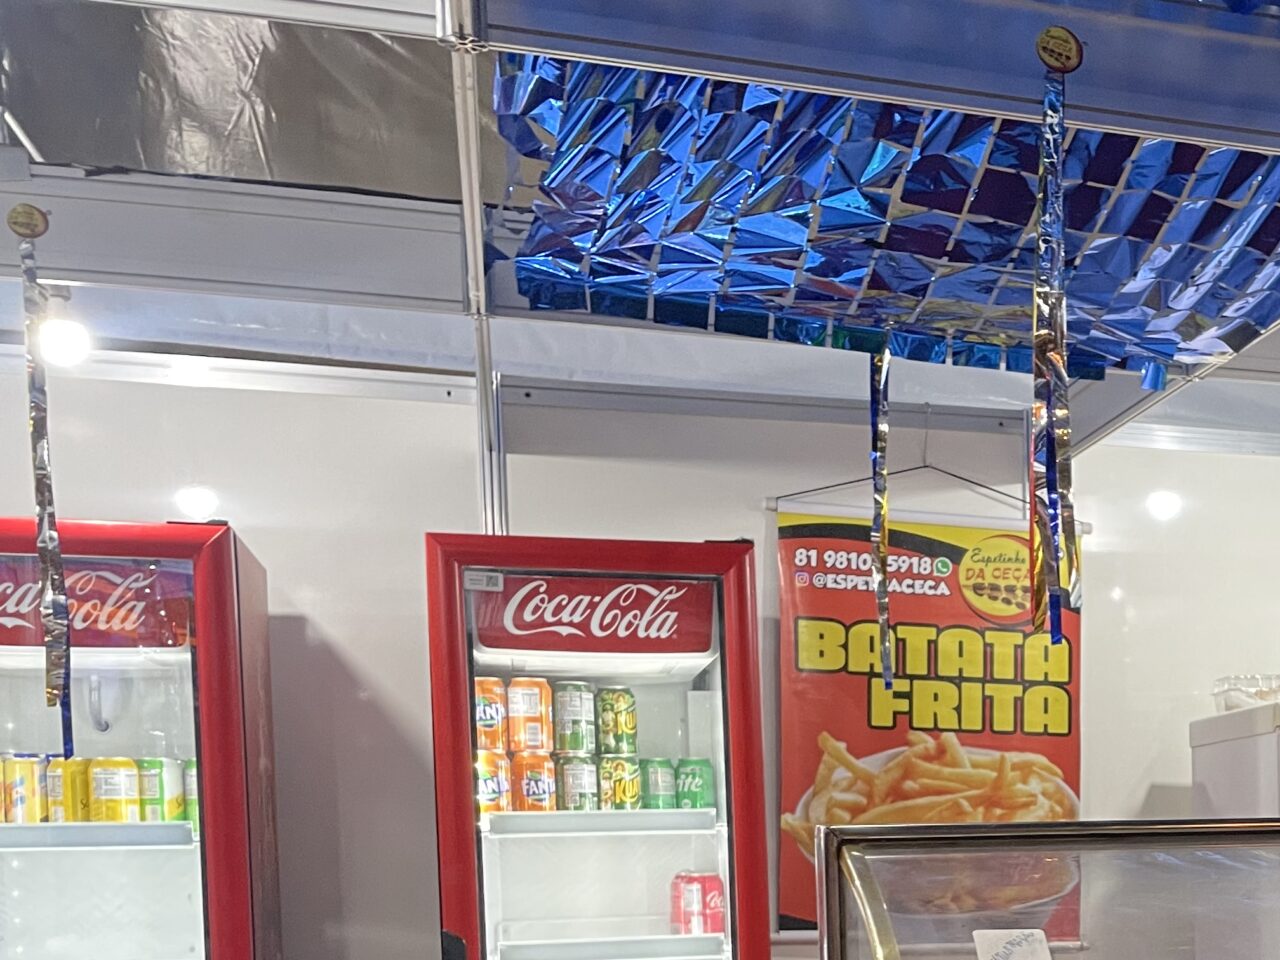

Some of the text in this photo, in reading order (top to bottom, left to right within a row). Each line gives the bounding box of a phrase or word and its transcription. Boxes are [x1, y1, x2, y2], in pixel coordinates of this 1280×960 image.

[795, 549, 932, 575] 81 98105918
[970, 547, 1027, 567] Espetinho
[812, 572, 951, 596] @ESPETACECA
[965, 567, 986, 581] DA
[503, 580, 687, 639] Coca-Cola
[796, 617, 1071, 684] BATATA
[868, 676, 1071, 736] FRITA
